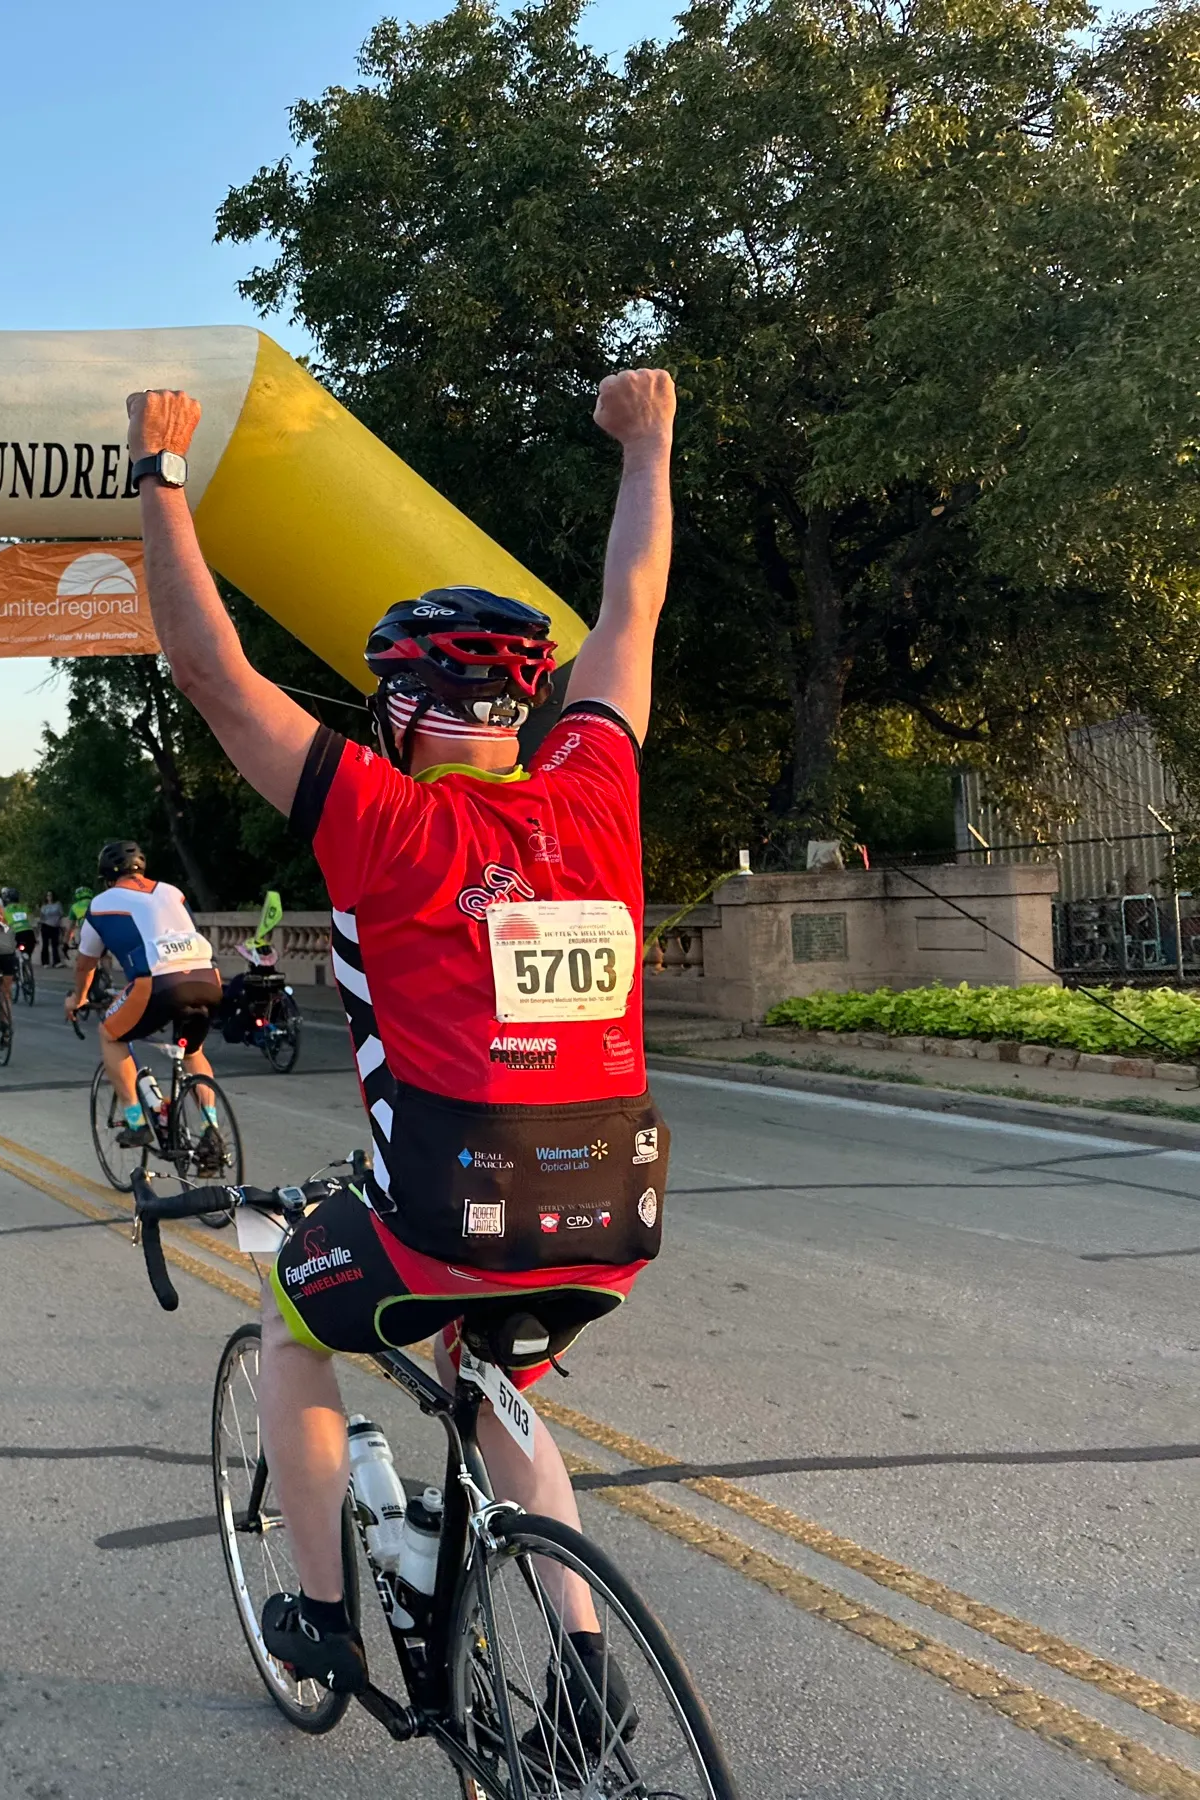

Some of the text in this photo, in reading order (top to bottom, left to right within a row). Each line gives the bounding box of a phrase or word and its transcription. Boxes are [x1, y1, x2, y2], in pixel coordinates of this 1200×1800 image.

[412, 605, 456, 618] Giro
[84, 632, 101, 640] Hell
[102, 631, 138, 640] Hundred
[514, 948, 617, 995] 5703
[490, 1037, 557, 1050] AIRWAYS
[490, 1050, 557, 1063] FREIGHT
[474, 1151, 505, 1160] BEALL
[536, 1145, 590, 1160] Walmart
[474, 1160, 515, 1169] BARCLAY
[540, 1161, 590, 1173] Optical Lab
[538, 1203, 565, 1212] JEFFREY
[578, 1200, 612, 1210] WILLIAMS
[471, 1219, 498, 1232] JAMES
[566, 1215, 590, 1226] CPA
[285, 1246, 352, 1286] Fayetteville
[301, 1267, 364, 1297] WHEELMEN
[499, 1380, 529, 1437] 5703
